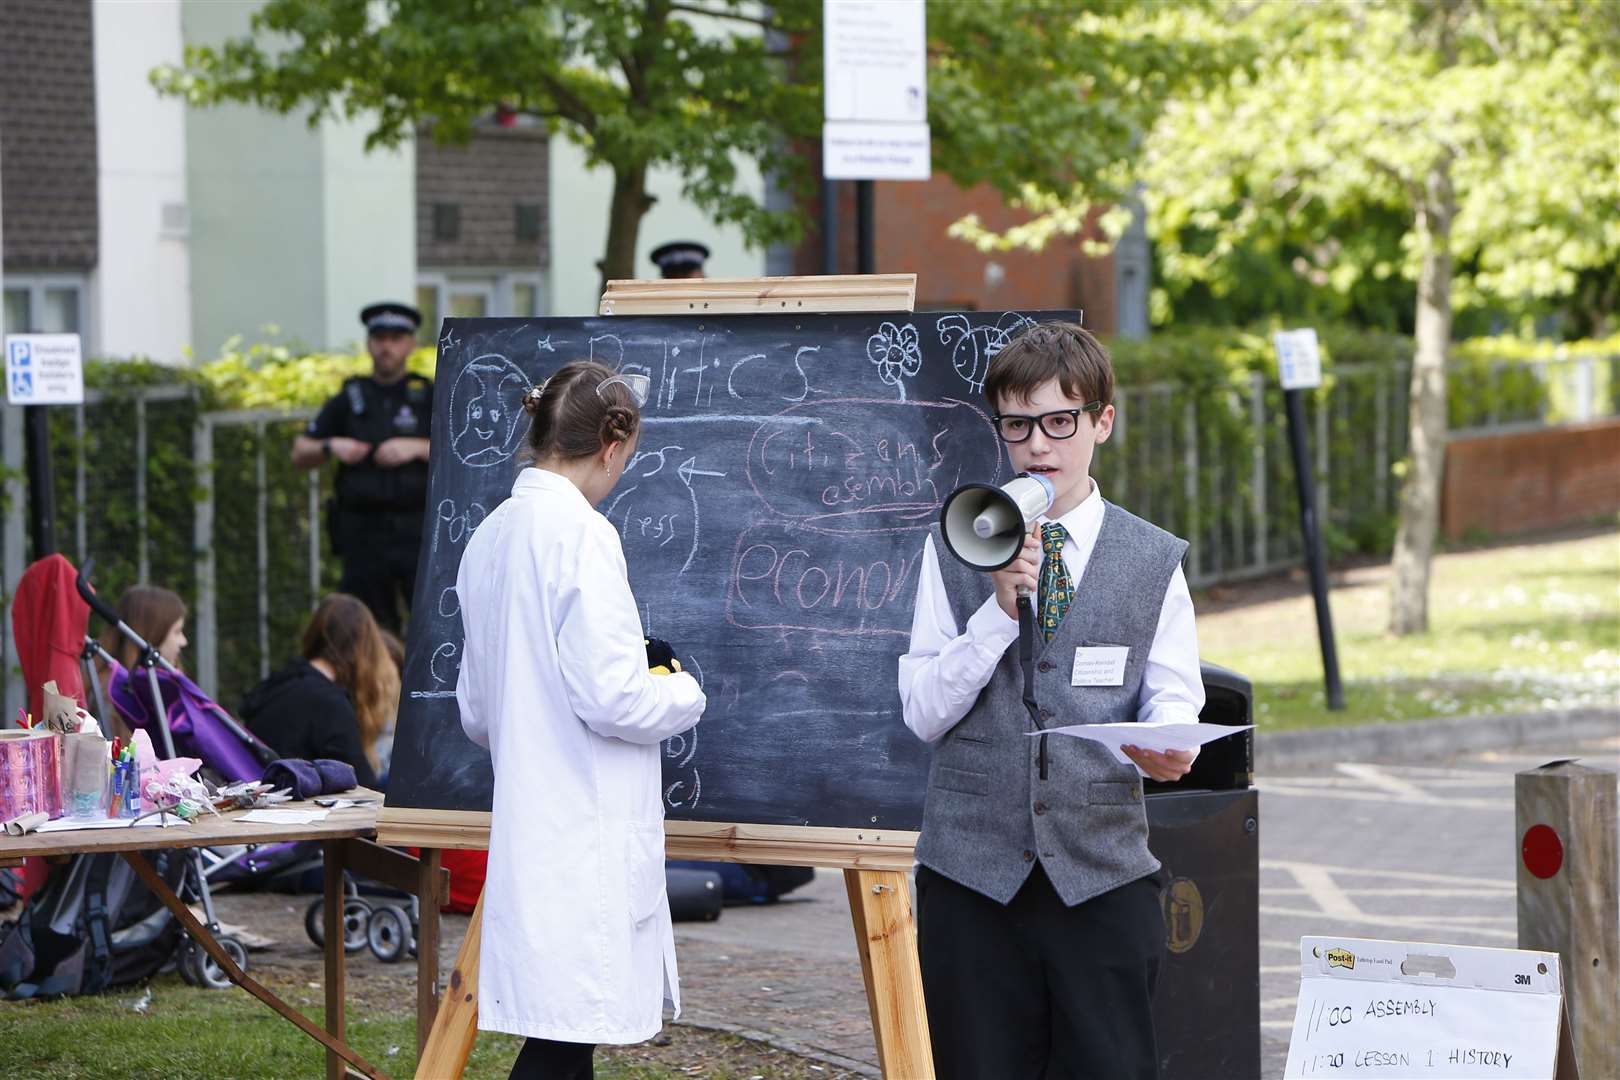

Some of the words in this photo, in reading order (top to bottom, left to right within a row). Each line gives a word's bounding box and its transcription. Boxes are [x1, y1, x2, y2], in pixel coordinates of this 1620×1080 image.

[1327, 953, 1353, 963] Post-it
[1514, 974, 1531, 985] 3M
[1364, 999, 1438, 1019] ASSEMBLY
[1354, 1050, 1410, 1068] LESSON
[1448, 1049, 1513, 1069] HISTORY
